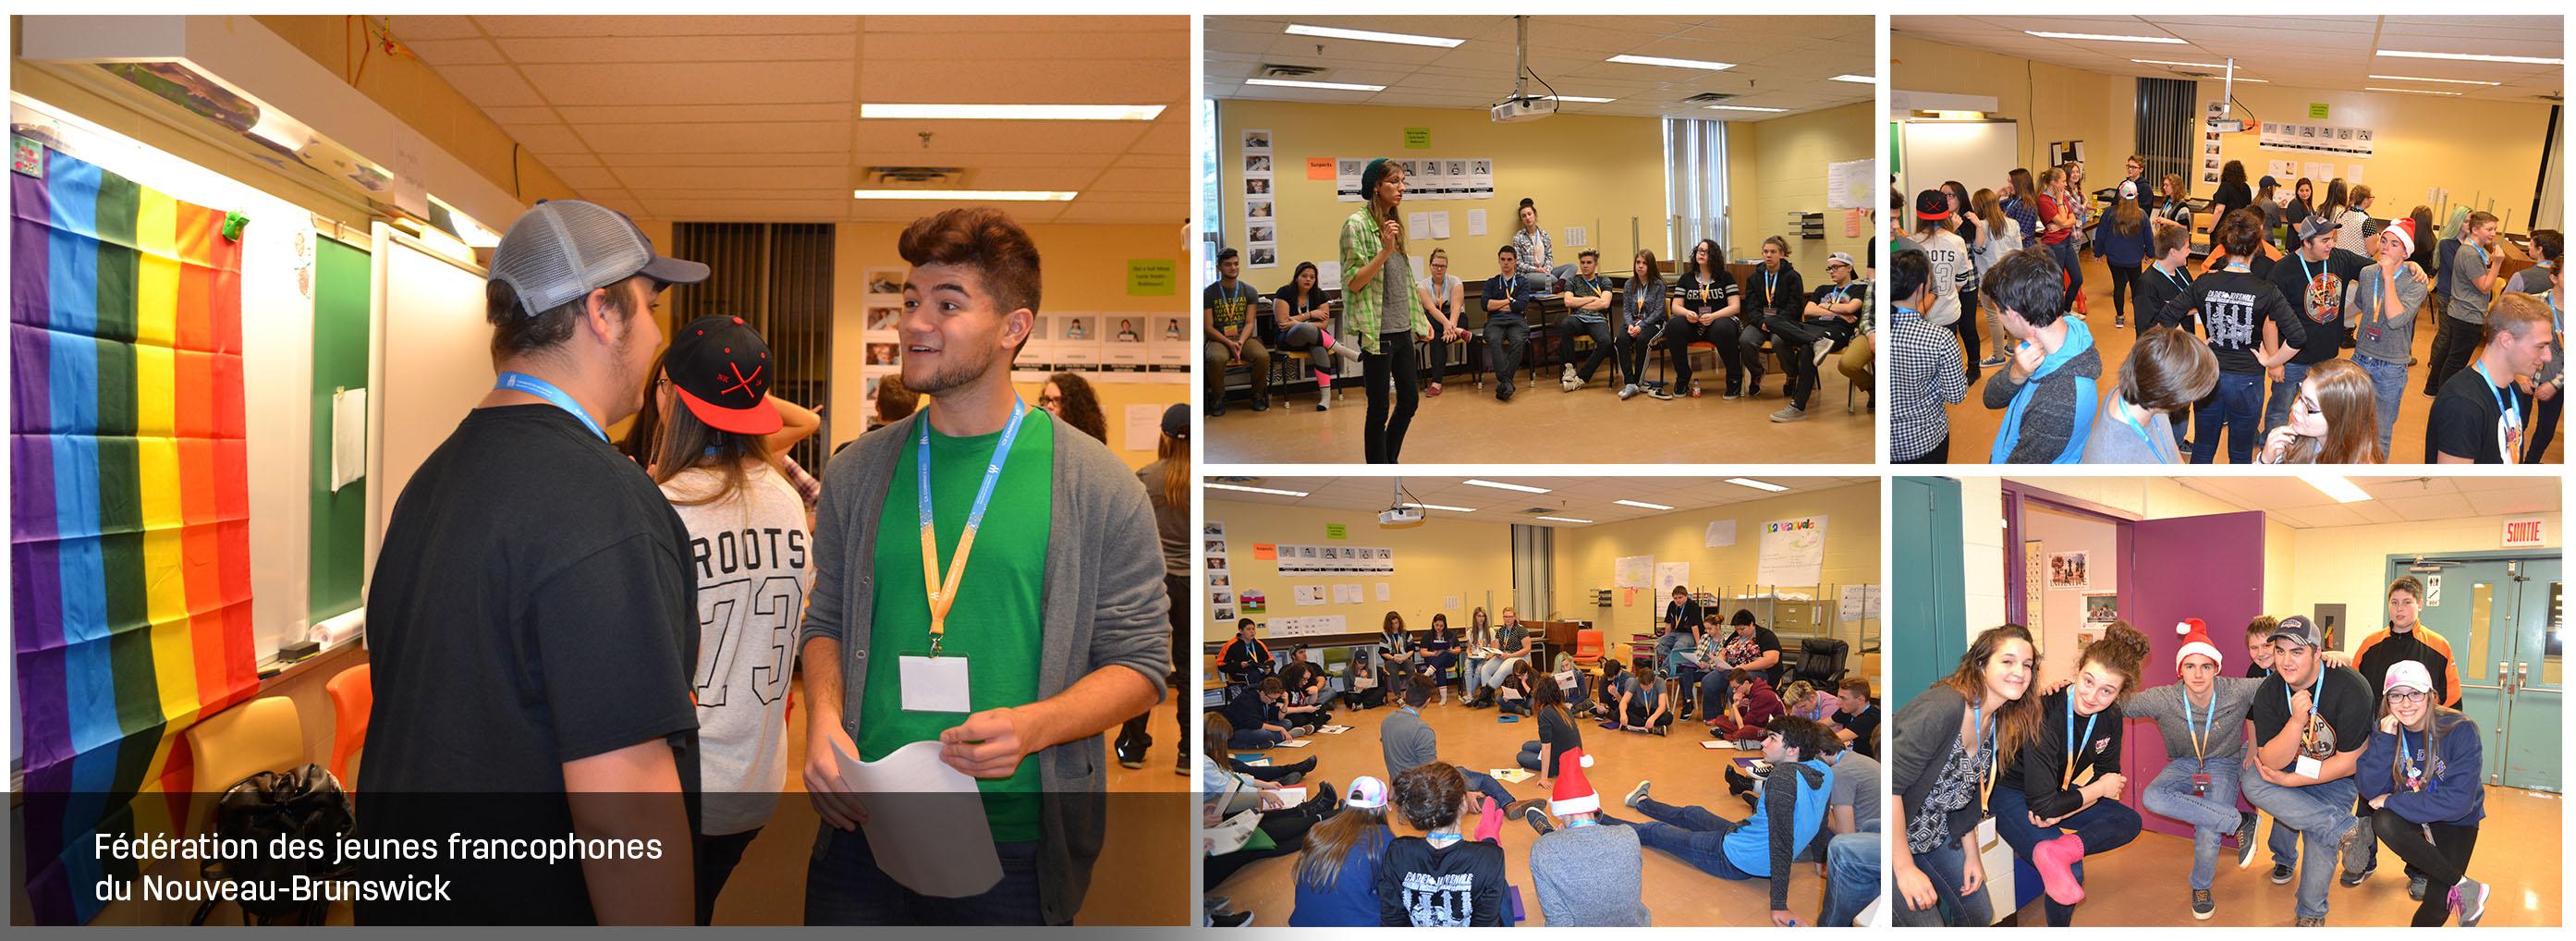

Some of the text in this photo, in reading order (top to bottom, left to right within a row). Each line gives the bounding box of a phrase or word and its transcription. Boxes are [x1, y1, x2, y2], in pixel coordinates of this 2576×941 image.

[690, 528, 805, 579] ROOTS
[2506, 520, 2542, 543] SORTIE
[697, 576, 802, 707] 73
